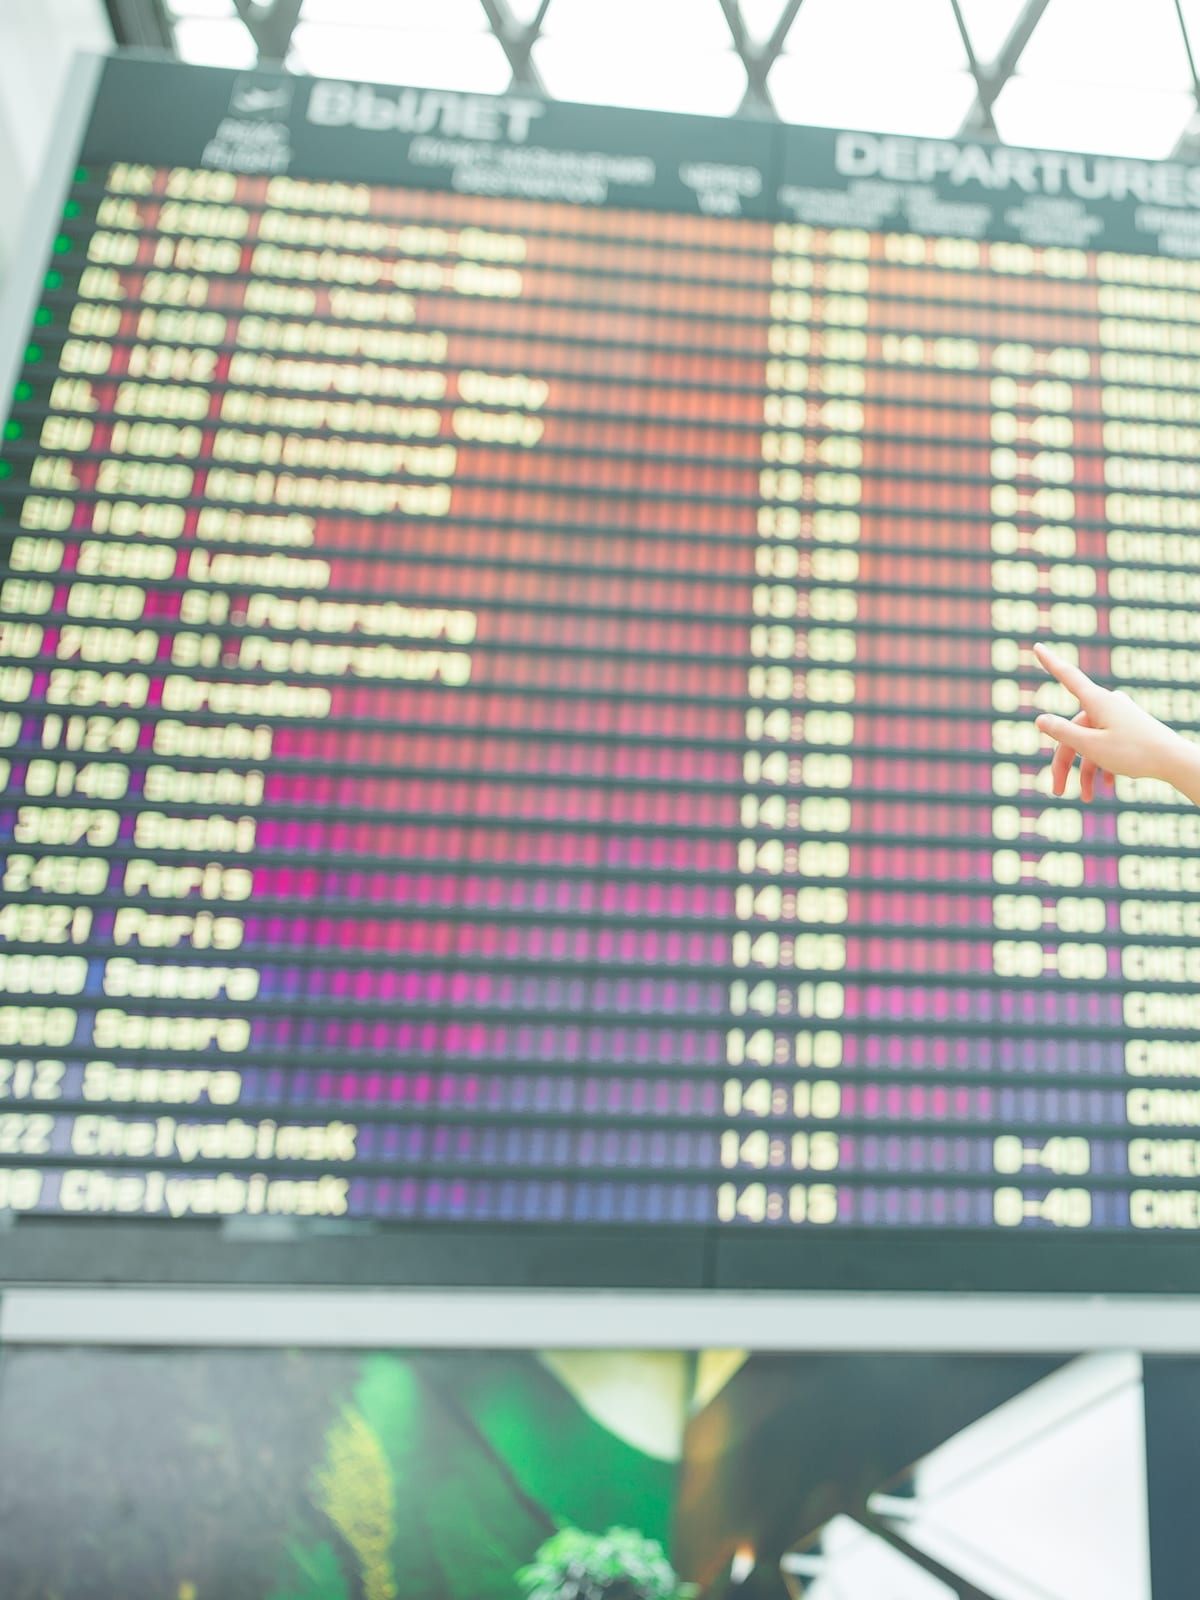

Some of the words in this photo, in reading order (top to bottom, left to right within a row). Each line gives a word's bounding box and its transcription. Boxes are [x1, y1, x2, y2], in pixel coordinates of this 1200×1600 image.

[306, 79, 545, 143] ВЫЛЕТ
[124, 859, 252, 902] Paris
[113, 906, 243, 950] Paris
[729, 981, 845, 1019] 14:10
[726, 1028, 843, 1068] 14:10
[723, 1079, 841, 1119] 14:10
[72, 1115, 357, 1161] Chelyabinsk
[720, 1130, 839, 1170] 14:15
[60, 1170, 349, 1217] Chelyabinsk
[717, 1183, 837, 1223] 14:15
